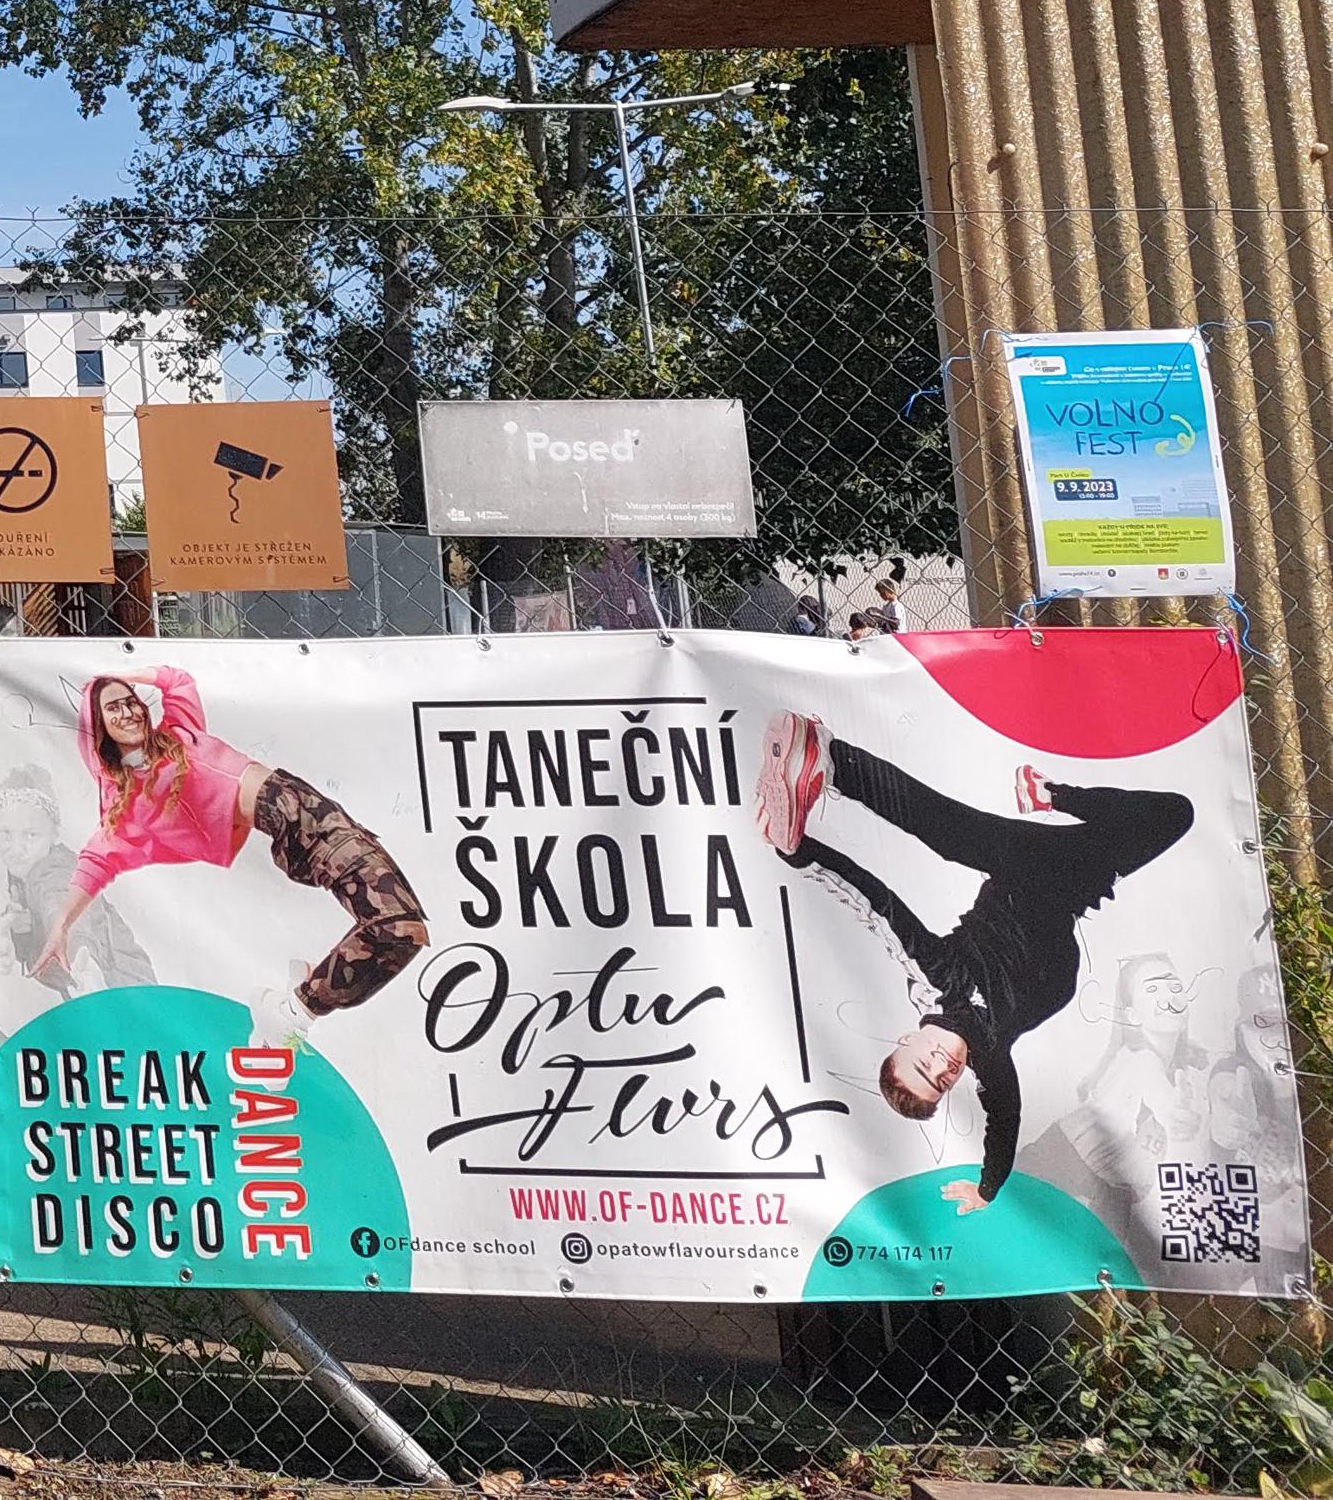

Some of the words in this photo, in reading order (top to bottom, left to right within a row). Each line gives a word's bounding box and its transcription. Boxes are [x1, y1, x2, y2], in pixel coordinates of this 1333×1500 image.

[1045, 398, 1164, 427] VOLNO
[1076, 431, 1143, 455] FEST
[1083, 481, 1114, 492] 2023
[169, 554, 252, 566] KAMEROVÝM
[182, 543, 230, 553] OBJEKT
[236, 543, 249, 552] JE
[255, 540, 312, 552] STŘEŽEN
[438, 710, 741, 808] TANEČNÍ
[455, 816, 752, 928] ŠKOLA
[16, 1048, 211, 1110] BREAK
[24, 1121, 220, 1185] STREET
[226, 1047, 311, 1260] DANCE
[509, 1187, 789, 1225] WWW.OF-DANCE.CZ
[30, 1194, 224, 1259] DISCO
[383, 1236, 465, 1254] OFdance
[473, 1239, 536, 1256] school
[596, 1240, 799, 1259] opatowflavoursdance
[857, 1246, 889, 1260] 774
[894, 1246, 923, 1260] 174
[928, 1246, 953, 1261] 117
